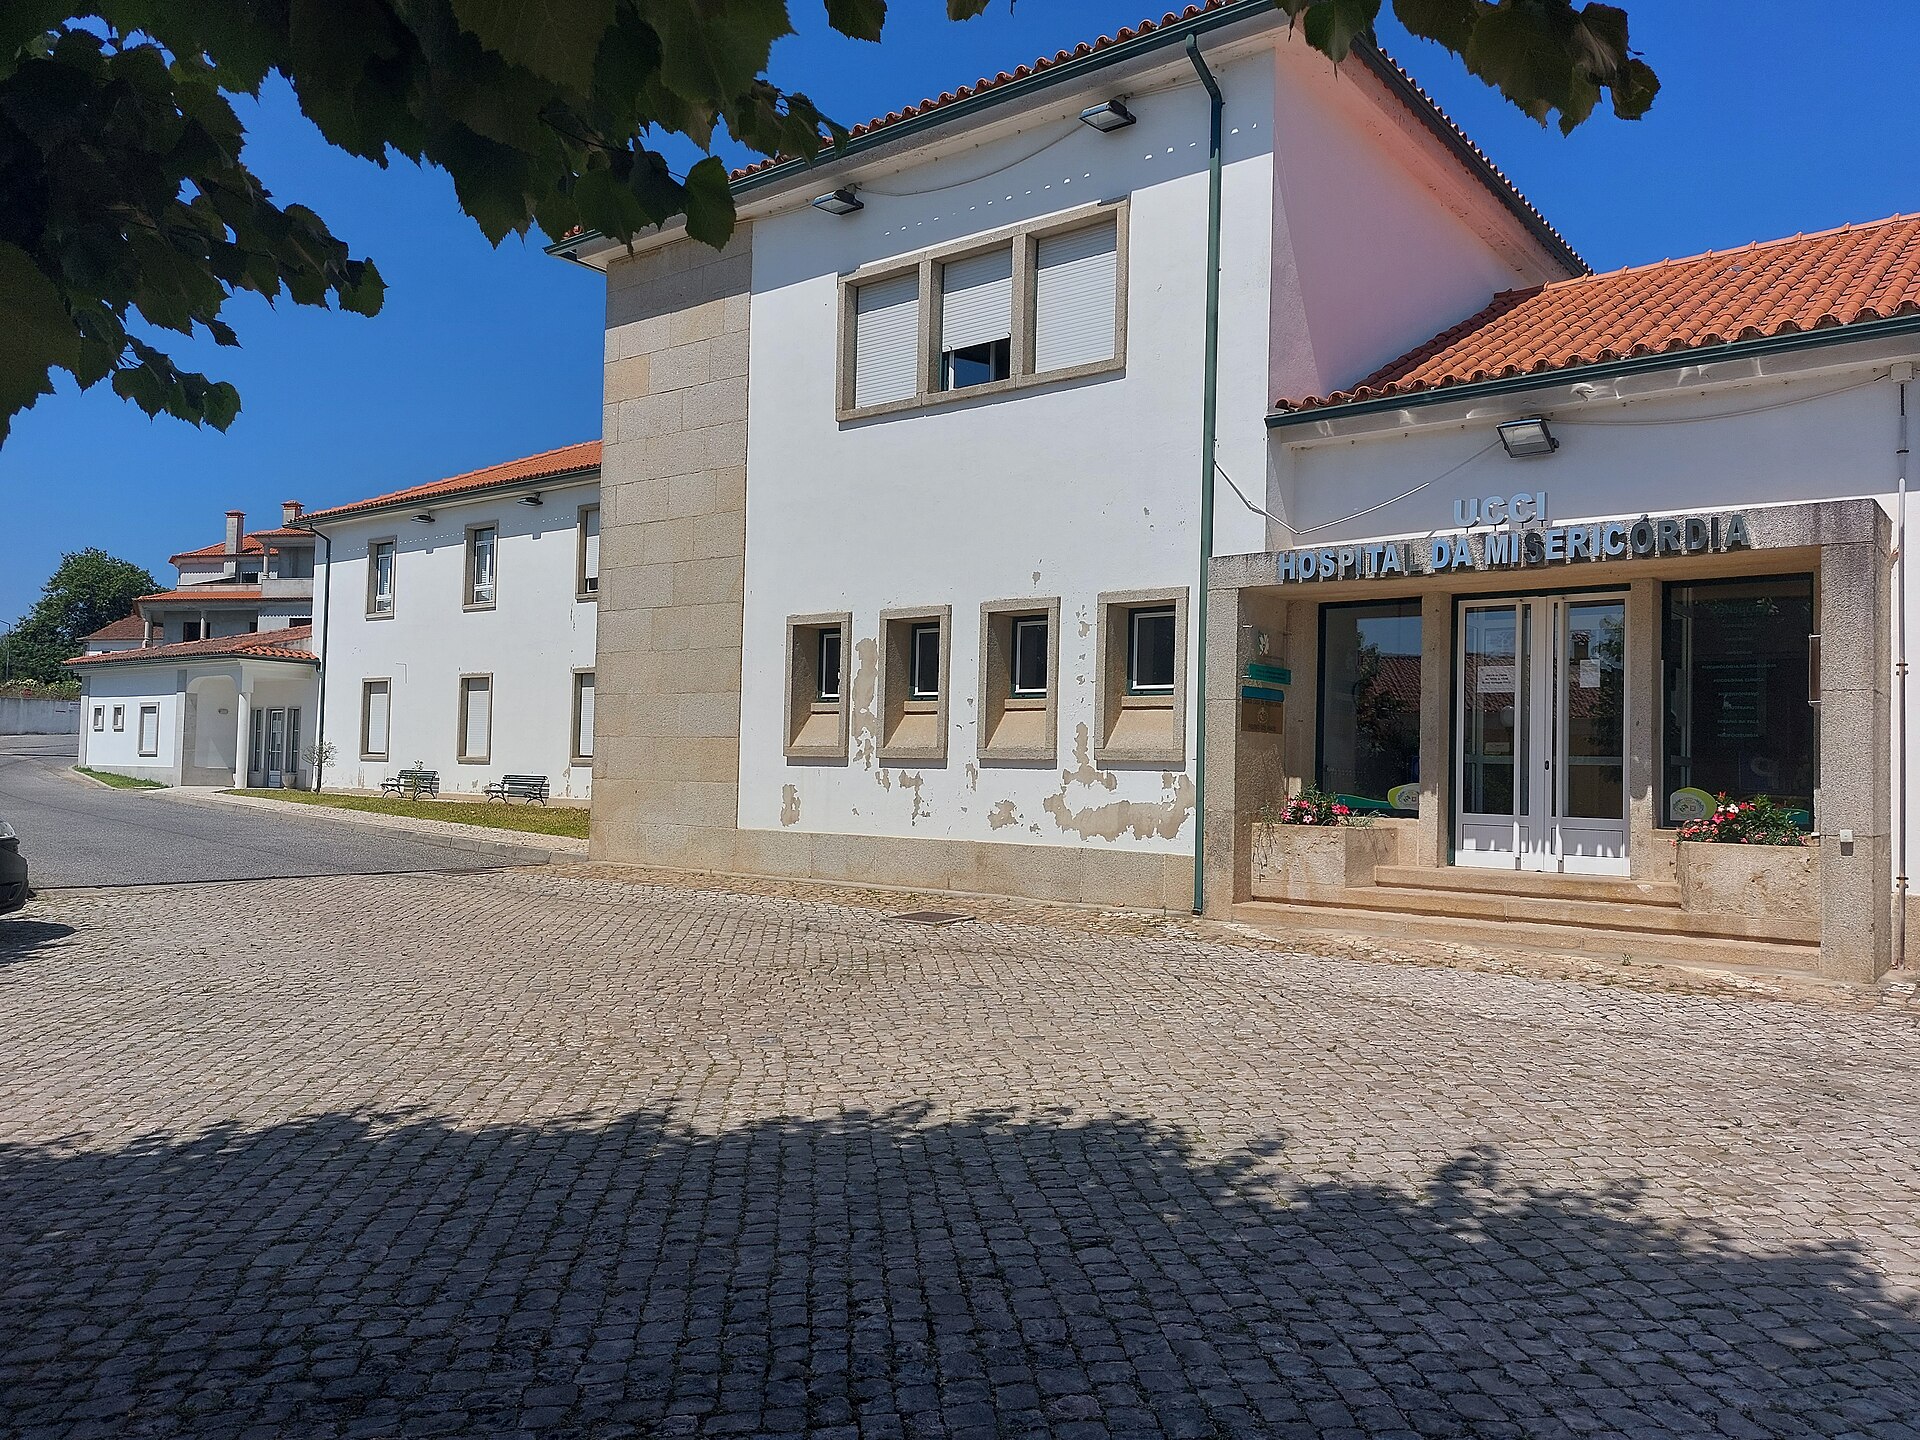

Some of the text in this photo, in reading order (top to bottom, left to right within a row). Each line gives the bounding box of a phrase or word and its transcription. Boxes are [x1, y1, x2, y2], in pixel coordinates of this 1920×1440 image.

[1453, 491, 1547, 528] UCCI
[1279, 514, 1750, 581] HOSPITAL DA MISERICÓRDIA
